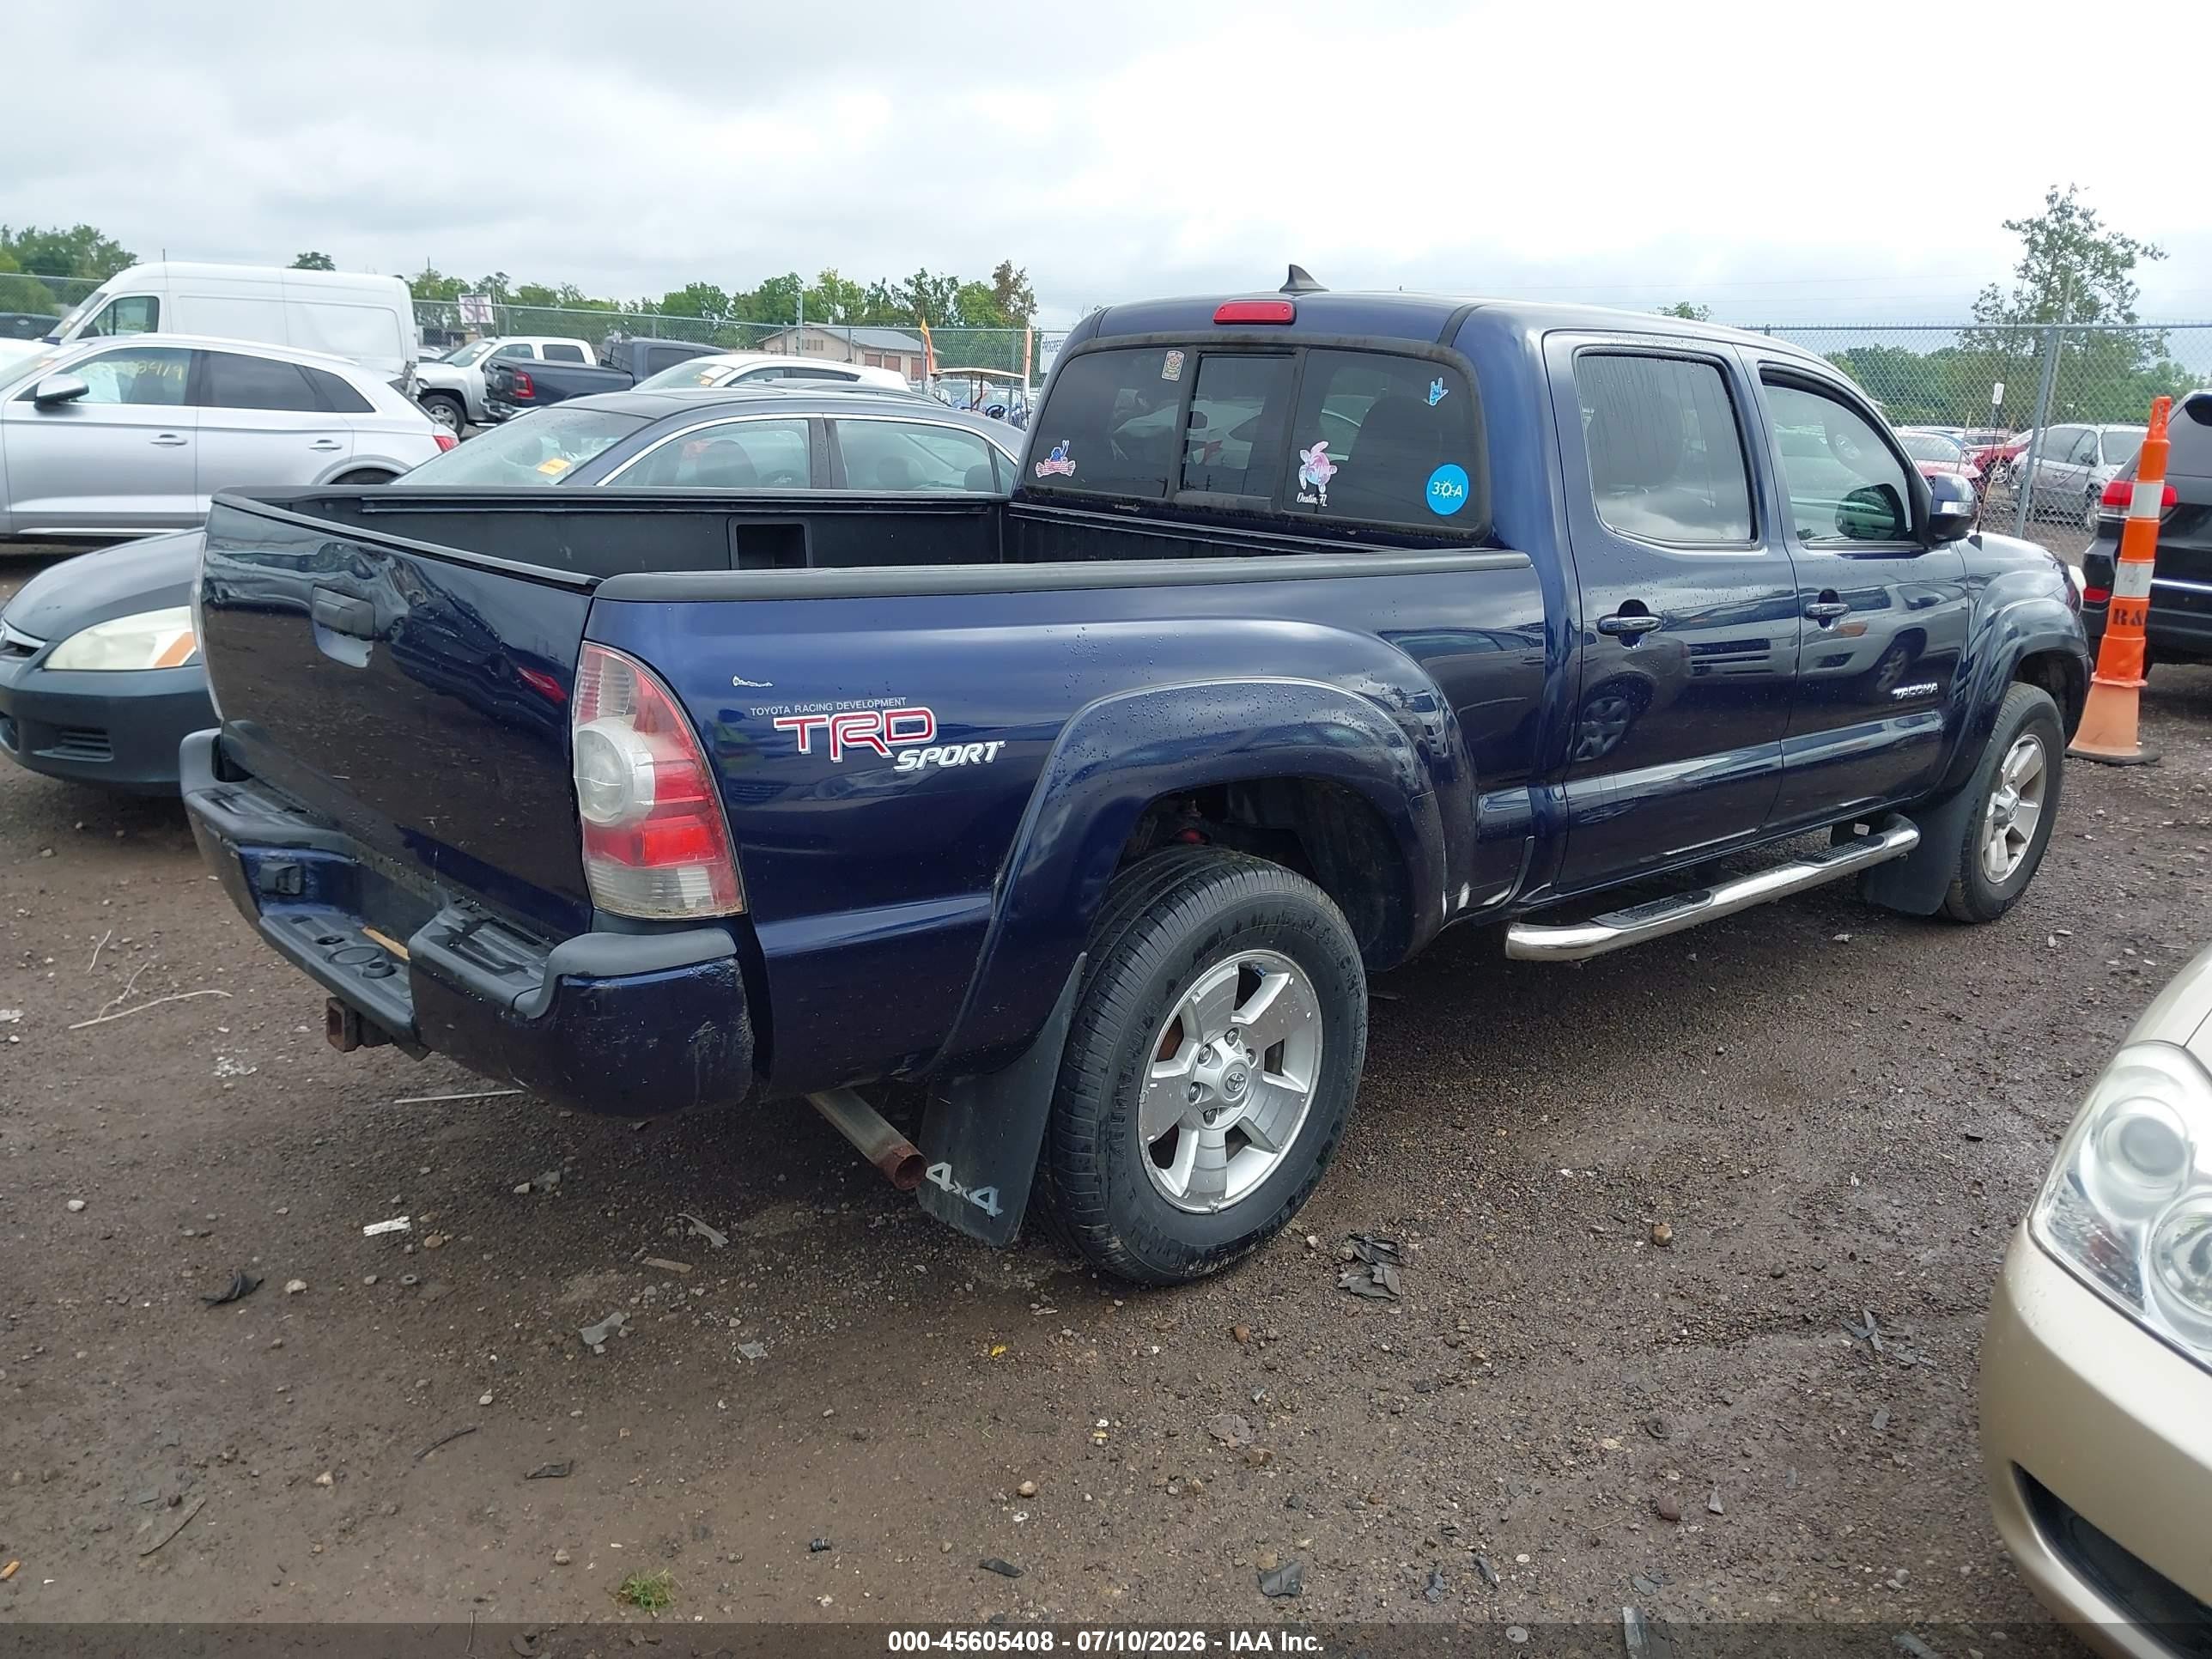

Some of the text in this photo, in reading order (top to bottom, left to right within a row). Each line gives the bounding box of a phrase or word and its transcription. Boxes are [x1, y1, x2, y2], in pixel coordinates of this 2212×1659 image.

[750, 696, 907, 716] TOYOTA RACING DEVELOPMENT
[773, 707, 938, 763] TRD
[893, 740, 1007, 773] SPORT
